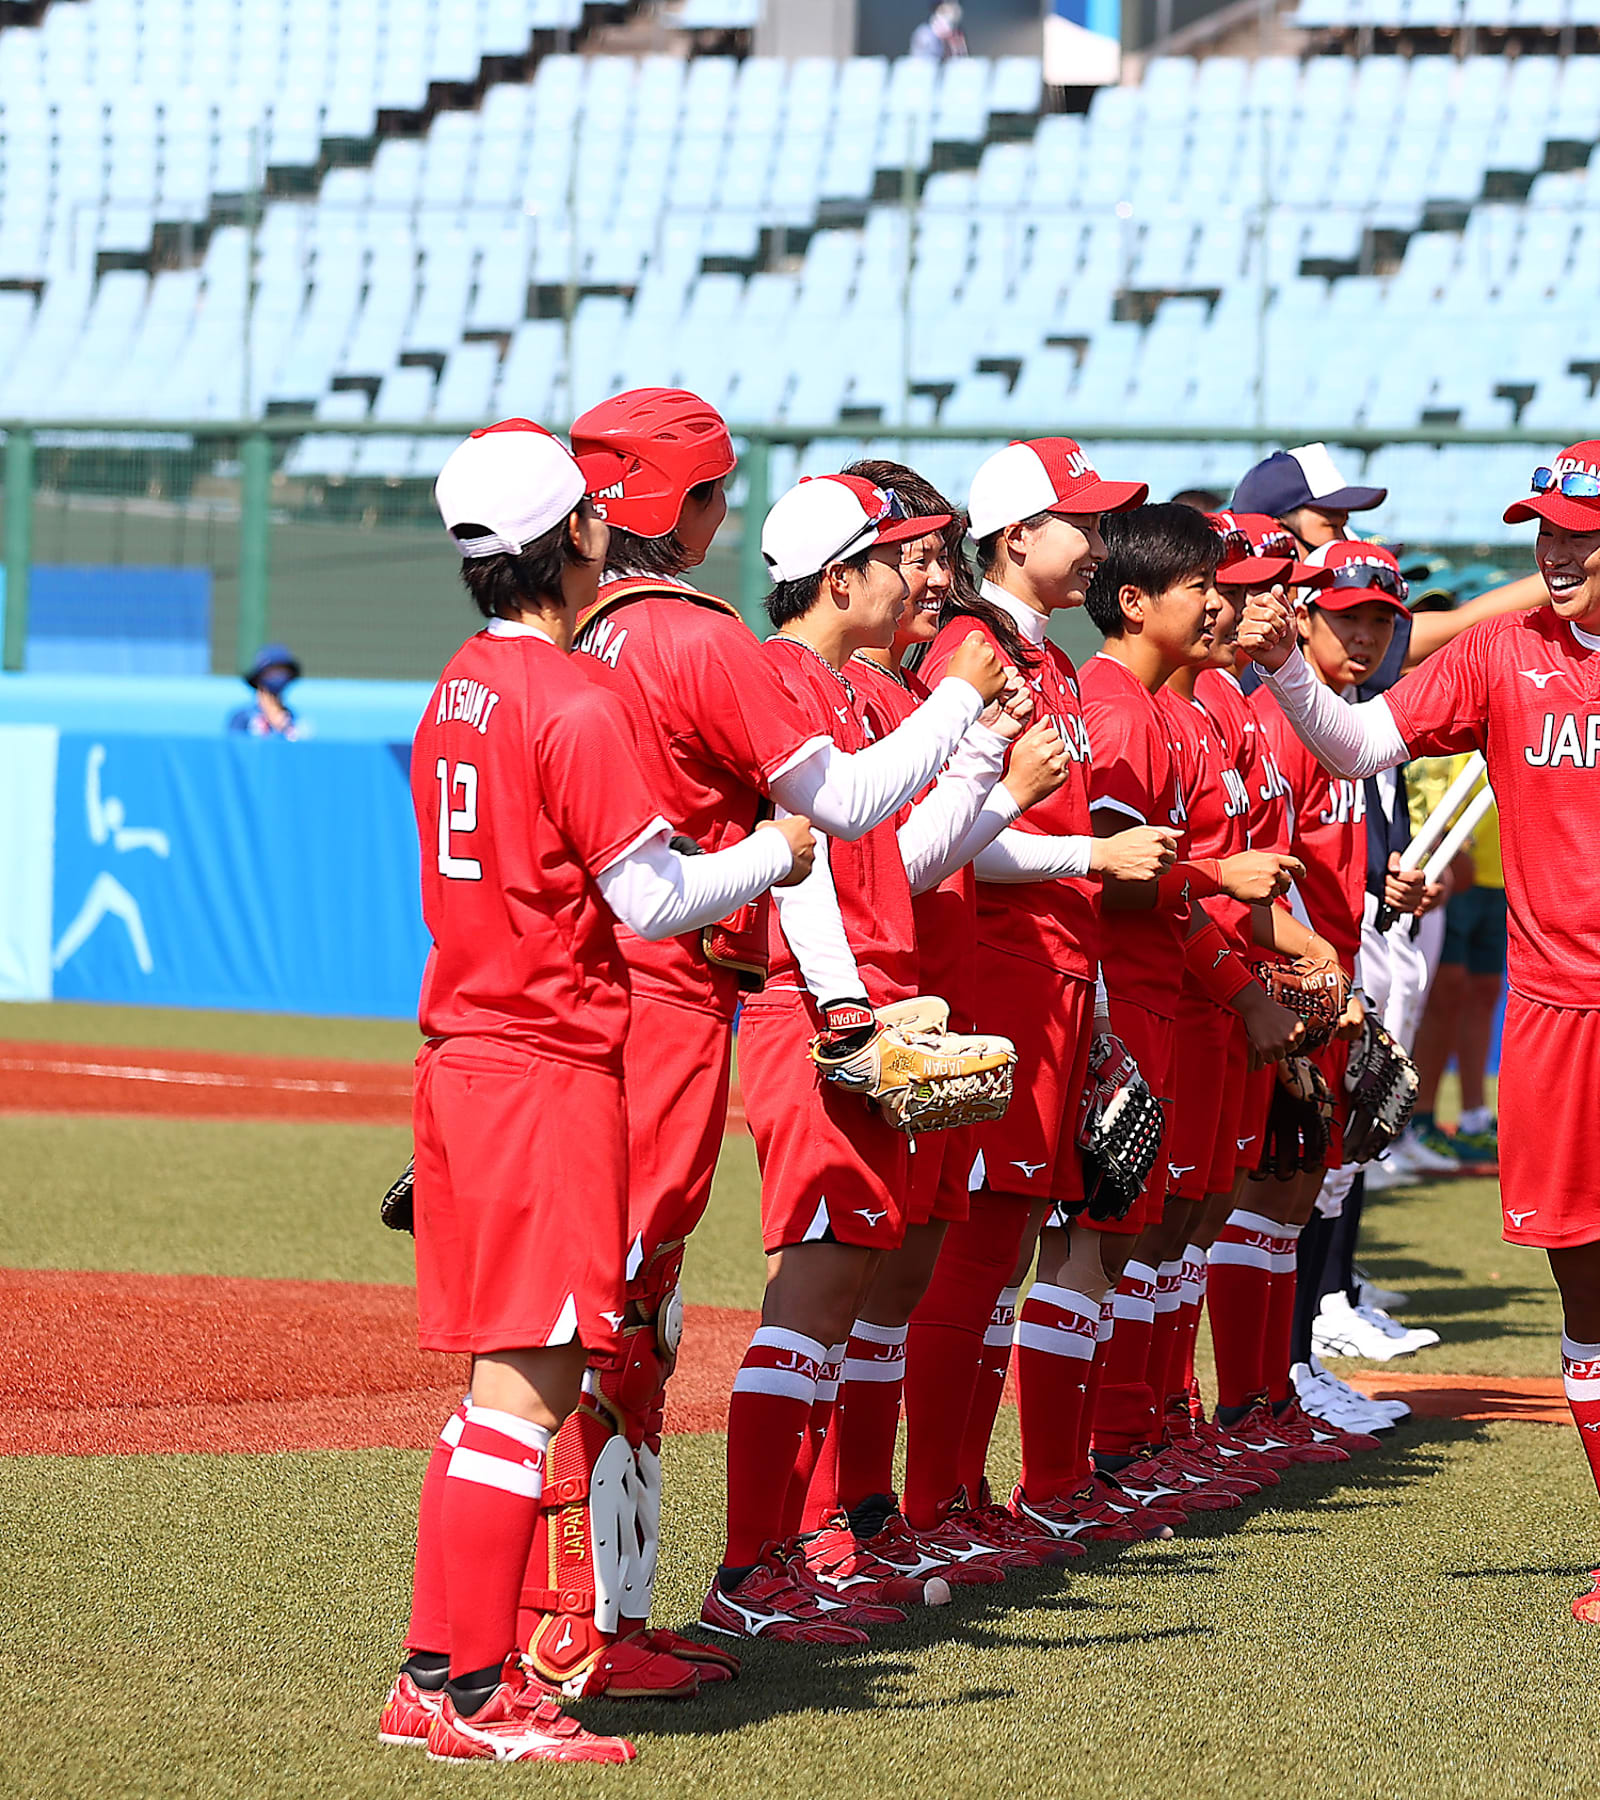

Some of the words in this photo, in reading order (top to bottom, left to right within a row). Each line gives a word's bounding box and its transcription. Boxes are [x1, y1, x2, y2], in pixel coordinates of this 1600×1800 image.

[571, 616, 629, 669] UMA
[435, 679, 500, 735] ATSUMI
[436, 757, 483, 880] 12
[828, 1011, 865, 1026] JAPAN
[922, 1058, 967, 1077] JAPAN
[1057, 1313, 1100, 1340] JA
[775, 1351, 821, 1381] JA
[874, 1343, 907, 1361] JA
